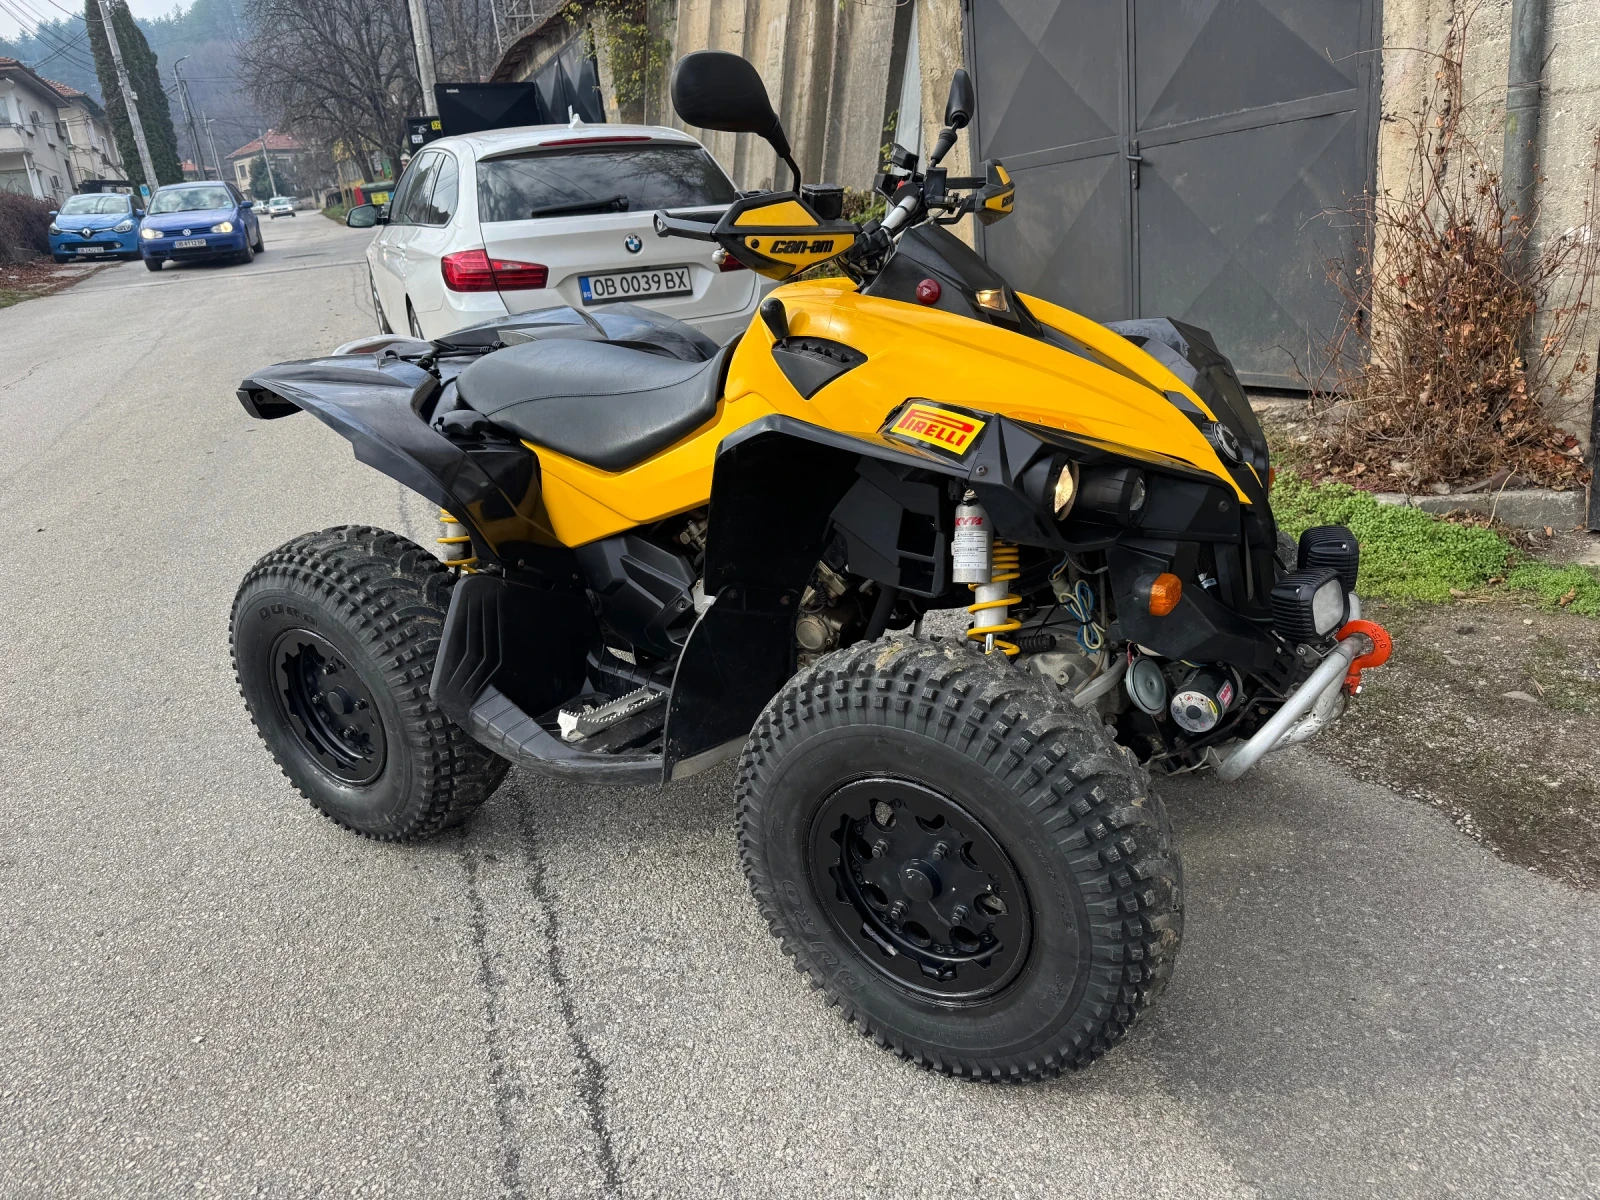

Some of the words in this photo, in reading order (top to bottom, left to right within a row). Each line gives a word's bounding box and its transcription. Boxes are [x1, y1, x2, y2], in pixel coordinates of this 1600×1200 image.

[593, 277, 617, 297] OB
[620, 273, 661, 294] 0039
[664, 270, 687, 290] BX
[898, 408, 975, 447] PIRELLI
